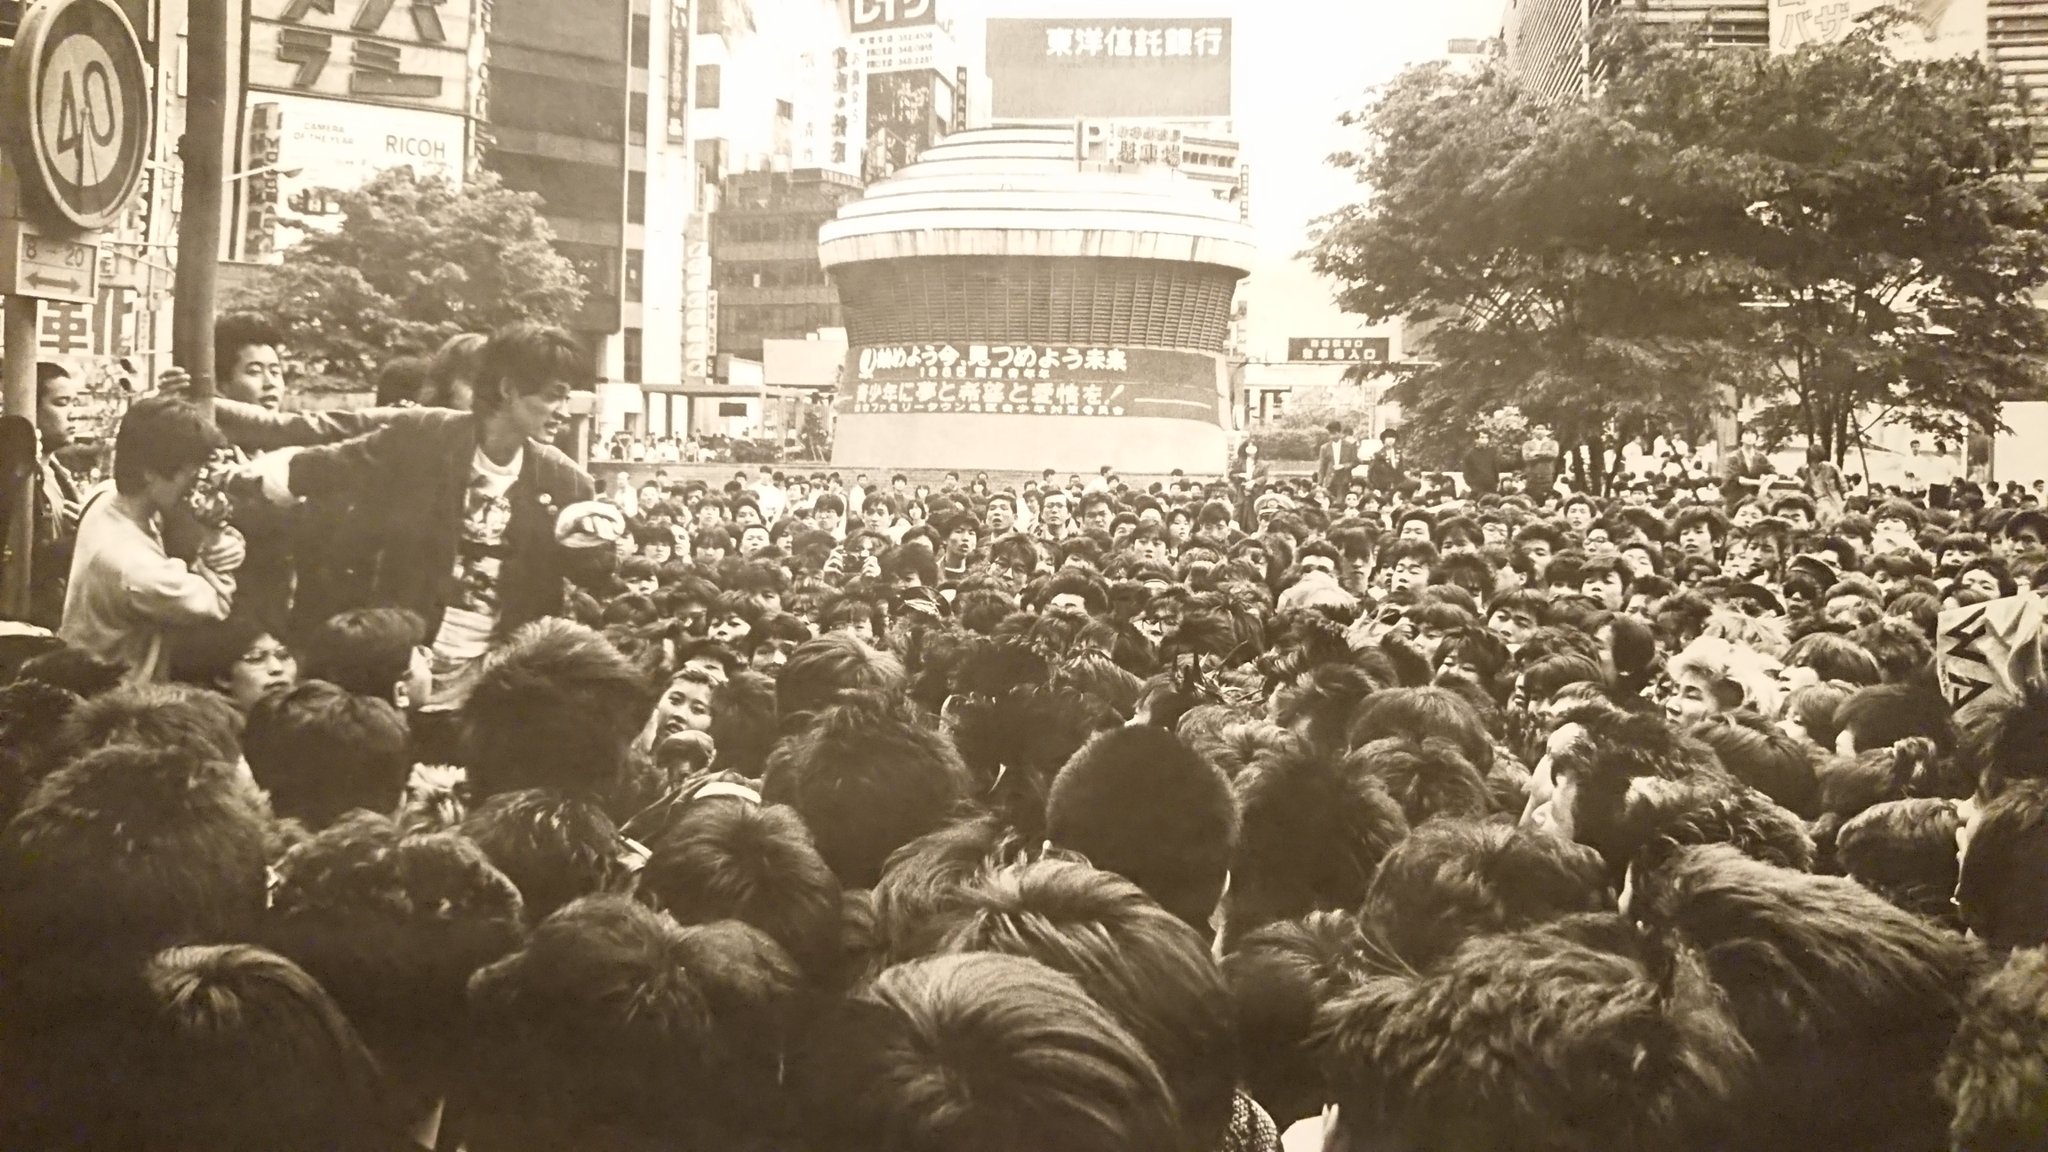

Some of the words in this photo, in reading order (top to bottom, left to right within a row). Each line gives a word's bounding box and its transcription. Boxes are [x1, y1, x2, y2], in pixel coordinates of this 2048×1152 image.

[1046, 27, 1222, 56] 東洋信託銀行
[57, 60, 116, 165] 40
[303, 122, 345, 133] CAMERA
[310, 135, 328, 143] THE
[331, 136, 354, 145] YEAR
[385, 135, 446, 159] RICOH
